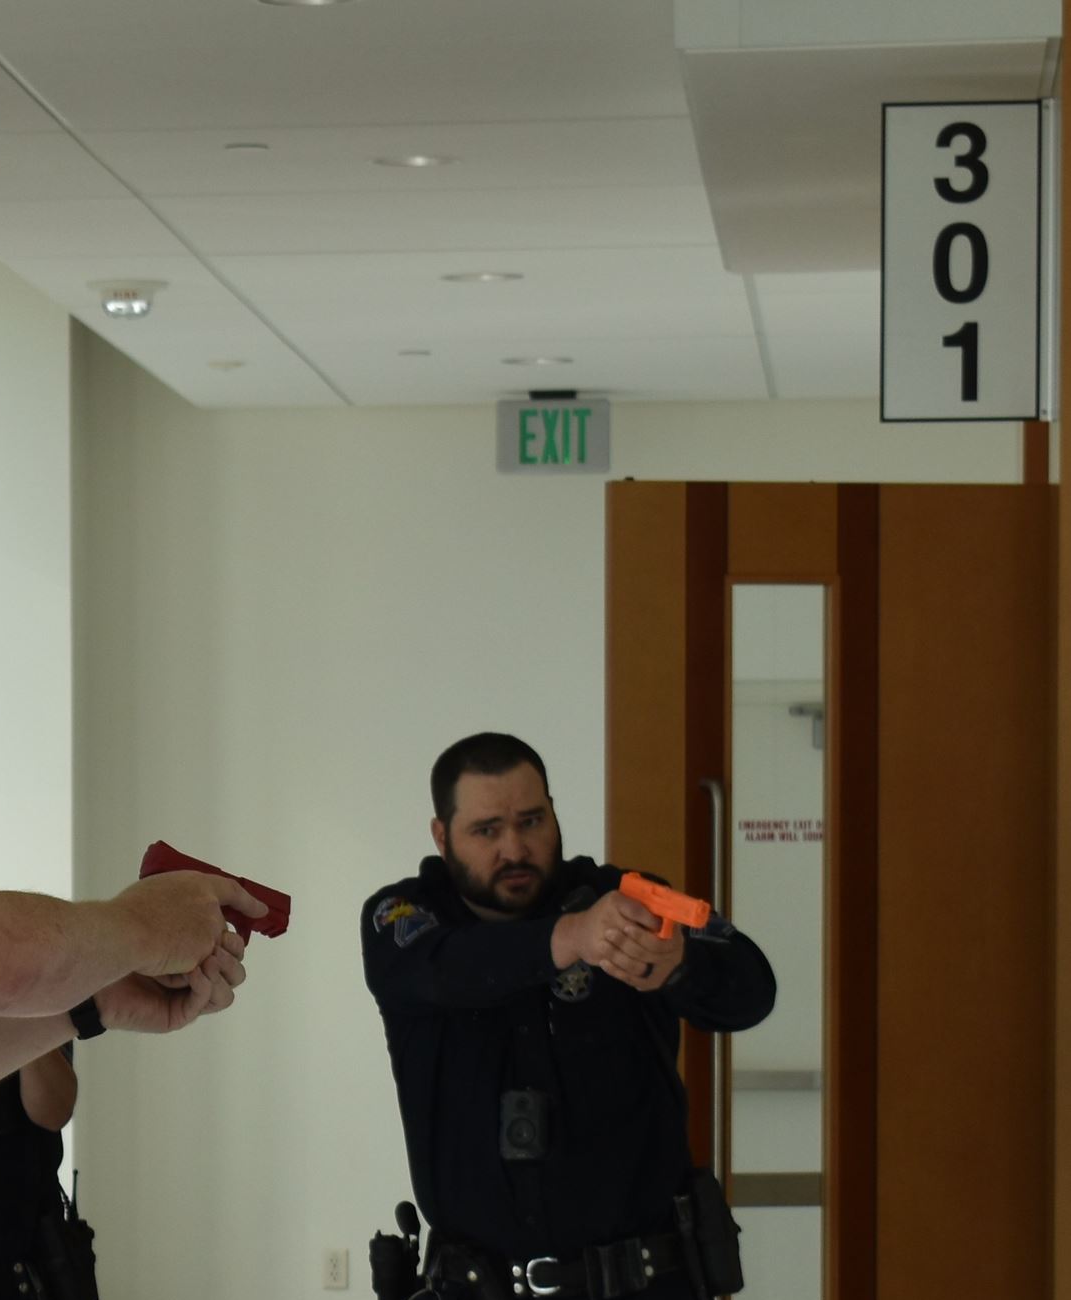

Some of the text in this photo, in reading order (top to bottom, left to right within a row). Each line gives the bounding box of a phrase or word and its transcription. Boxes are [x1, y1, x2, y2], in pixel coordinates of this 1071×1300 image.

[933, 121, 989, 402] 301
[519, 408, 591, 465] EXIT
[738, 820, 789, 830] EMERGENCY
[793, 820, 812, 830] EXIT
[744, 832, 775, 841] ALARM
[779, 832, 798, 841] WILL
